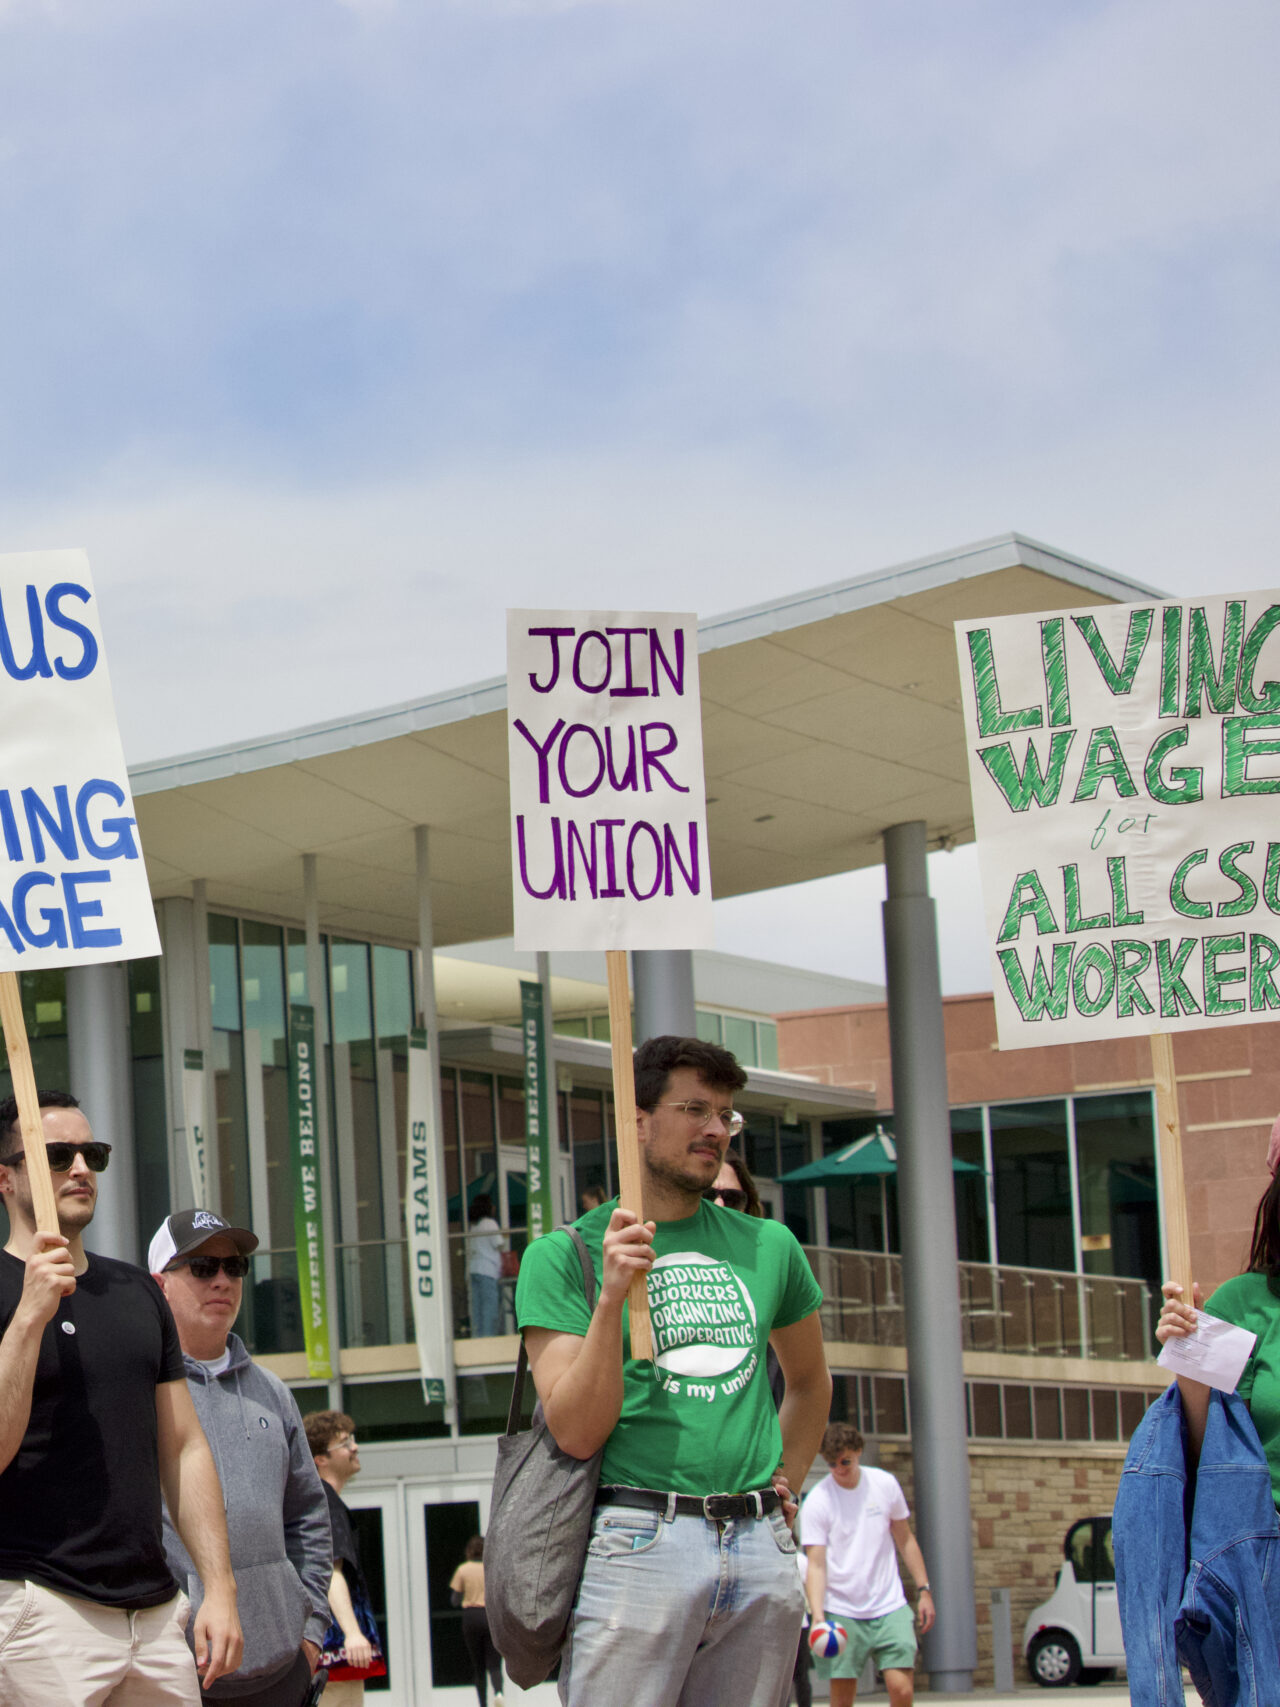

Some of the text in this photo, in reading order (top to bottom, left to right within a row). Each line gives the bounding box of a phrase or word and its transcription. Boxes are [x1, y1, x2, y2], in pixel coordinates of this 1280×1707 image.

[528, 627, 684, 697] JOIN
[966, 600, 1280, 738] LIVING
[513, 718, 690, 803] YOUR
[976, 714, 1280, 813] WAGE
[516, 815, 700, 901] UNION
[1091, 809, 1157, 850] for
[996, 856, 1144, 944] ALL
[996, 932, 1280, 1022] WORKER
[297, 1042, 314, 1157] BELONG
[525, 1019, 540, 1136] BELONG
[302, 1165, 317, 1213] WE
[528, 1145, 541, 1193] WE
[412, 1121, 433, 1297] GO RAMS
[646, 1267, 732, 1292] GRADUATE
[648, 1284, 739, 1307] WORKERS
[653, 1301, 746, 1328] ORGANIZING
[658, 1322, 754, 1350] COOPERATIVE
[662, 1375, 680, 1394] is
[687, 1382, 716, 1403] my
